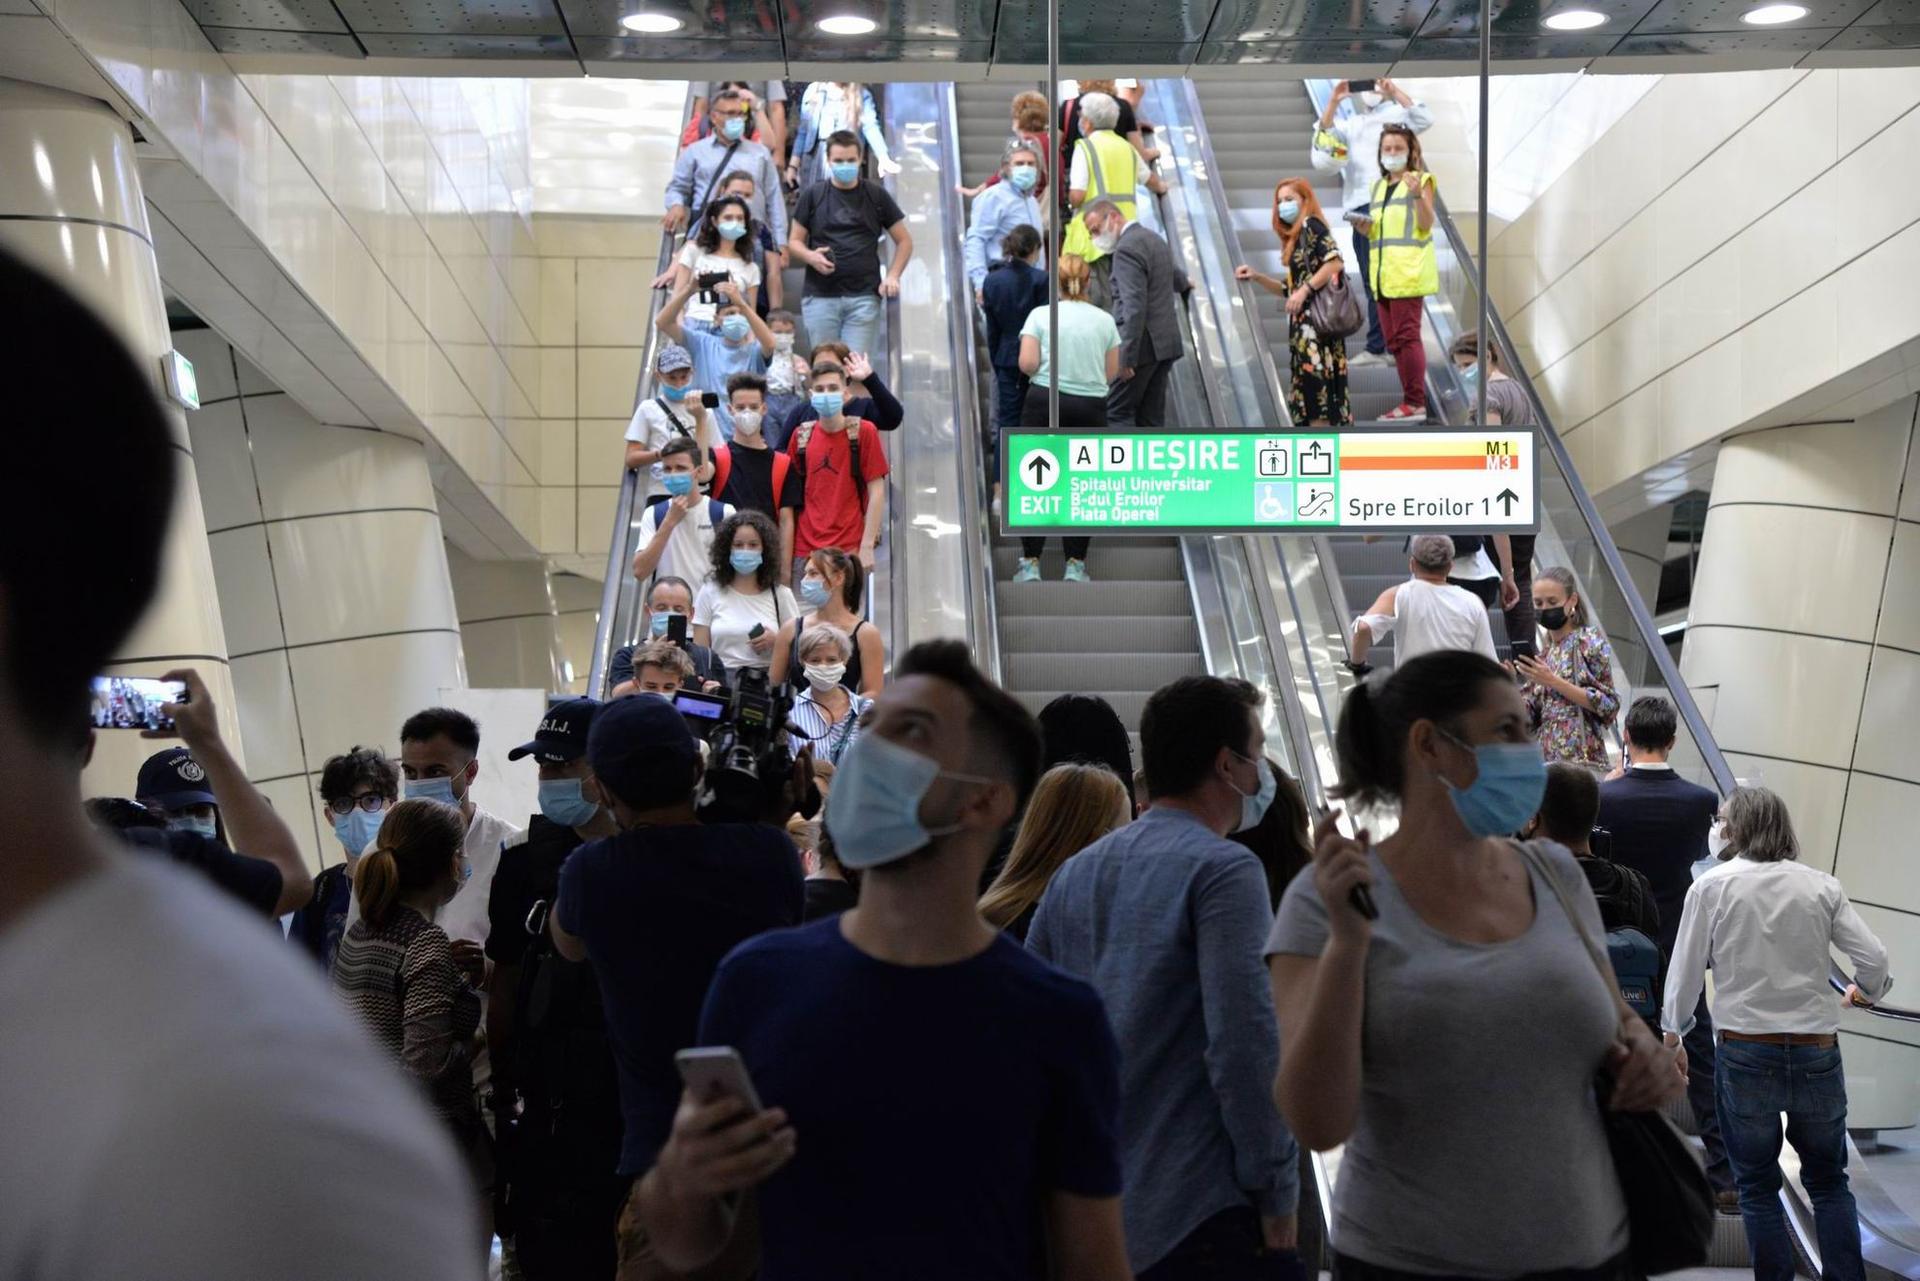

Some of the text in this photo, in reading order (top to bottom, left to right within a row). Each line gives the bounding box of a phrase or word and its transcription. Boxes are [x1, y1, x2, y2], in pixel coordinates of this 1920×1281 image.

[1486, 441, 1510, 455] M1
[1076, 440, 1240, 478] A D IEȘIRE
[1486, 456, 1511, 470] M3
[1070, 477, 1212, 495] Spitalul Universitar
[1020, 495, 1062, 515] EXIT
[1071, 491, 1165, 507] B-dul Eroilor
[1349, 497, 1489, 521] Spre Eroilor 1
